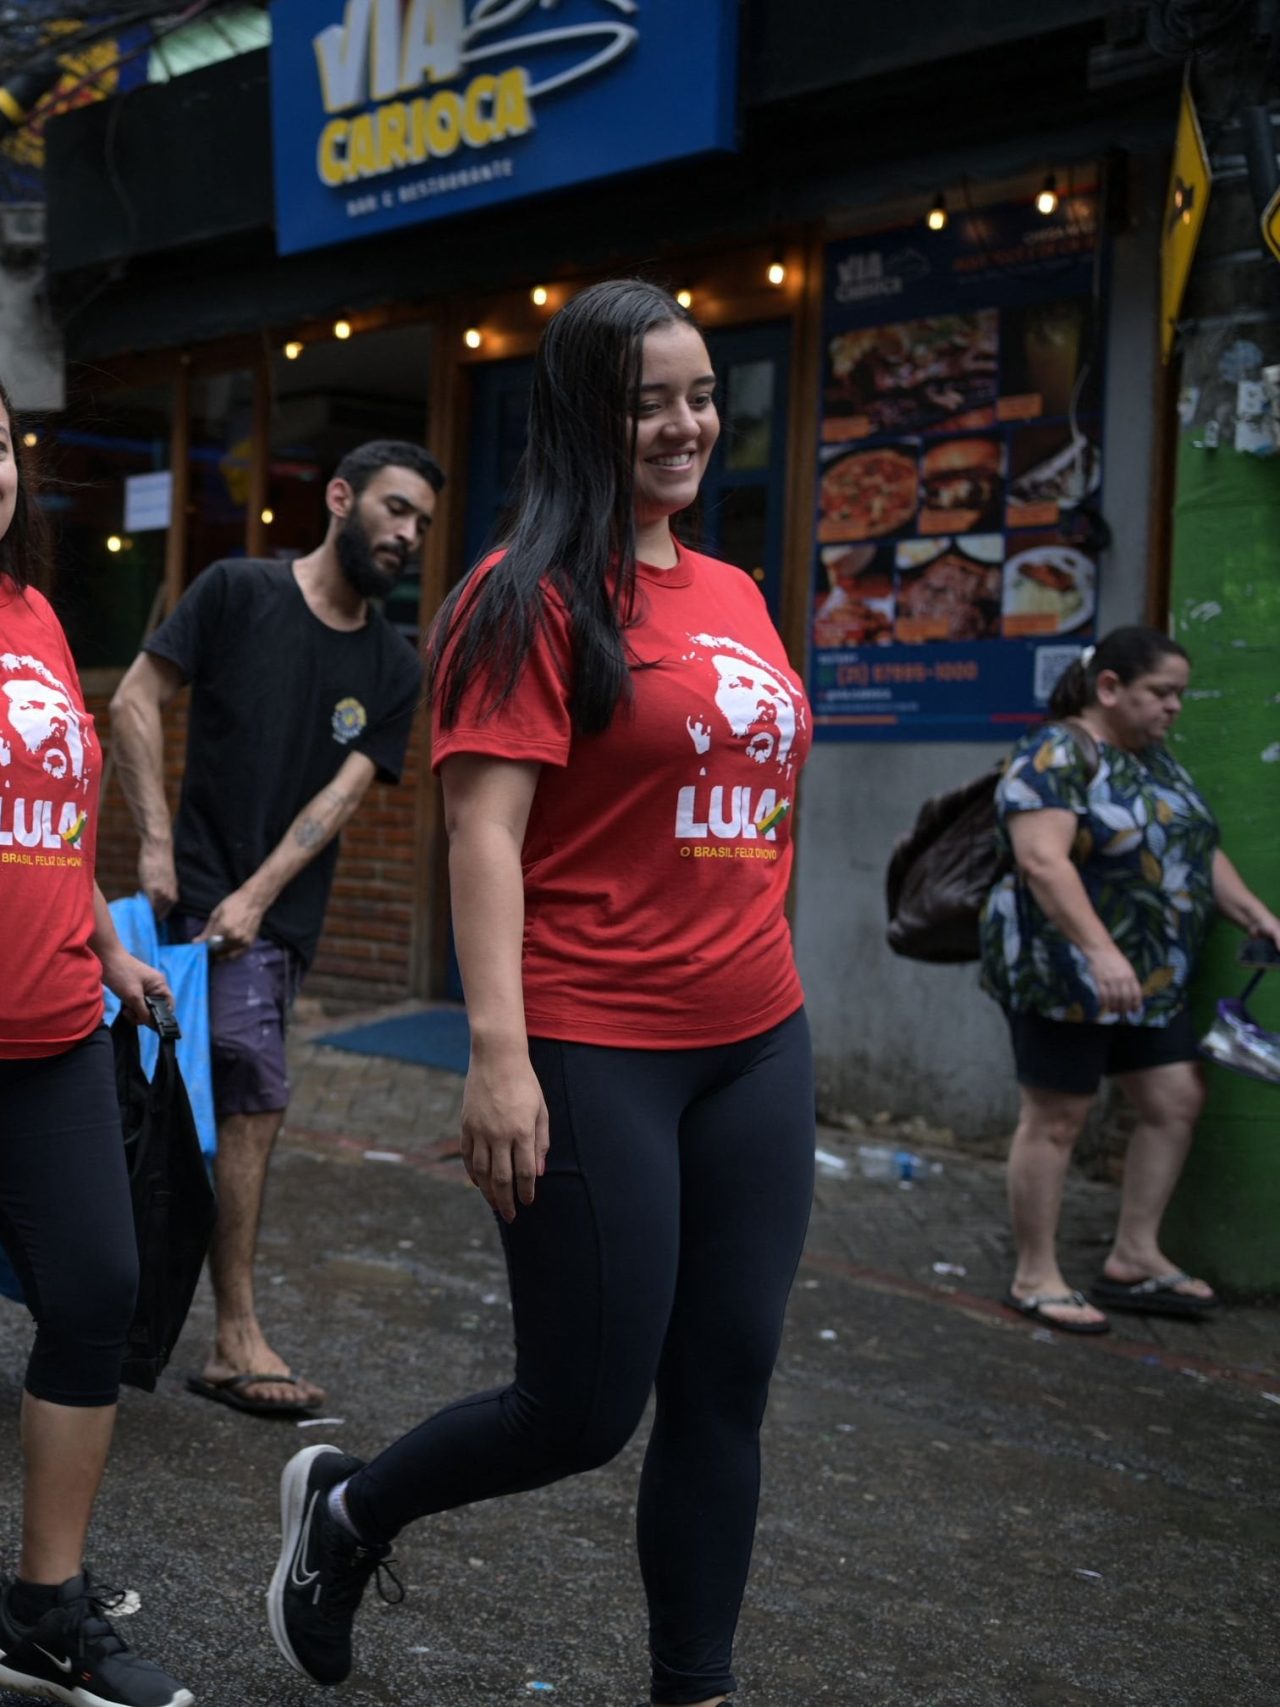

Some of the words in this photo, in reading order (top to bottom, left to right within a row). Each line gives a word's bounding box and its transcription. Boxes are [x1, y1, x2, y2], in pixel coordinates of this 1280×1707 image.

[313, 0, 465, 114] VIA
[318, 66, 534, 187] CARIOCA
[675, 785, 777, 841] LULA
[1, 853, 33, 865] BRASIL
[680, 846, 691, 857] O
[693, 846, 733, 858] BRASIL
